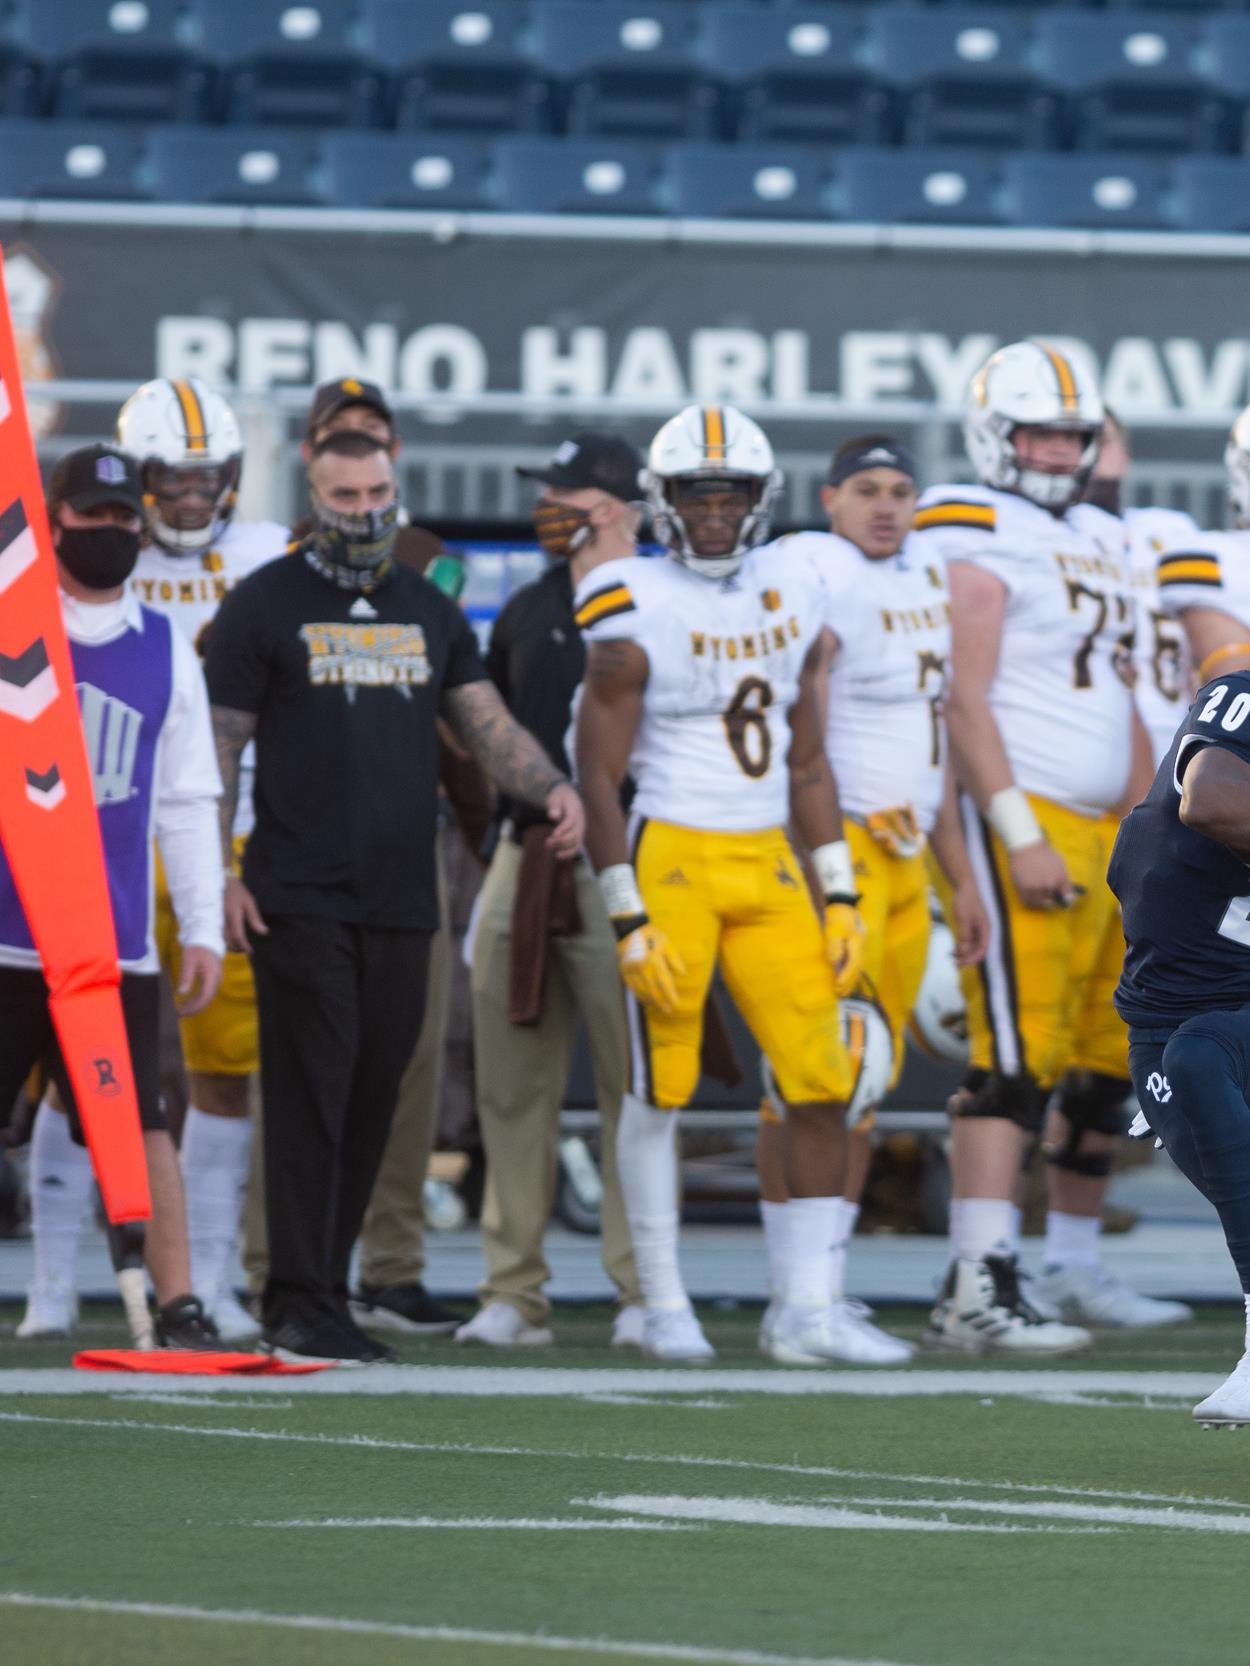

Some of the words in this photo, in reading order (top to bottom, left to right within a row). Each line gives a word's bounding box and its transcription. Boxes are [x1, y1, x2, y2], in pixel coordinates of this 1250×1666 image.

[155, 316, 488, 424] RENO
[521, 326, 1000, 426] HARLEY
[690, 616, 799, 661] WYOMING
[721, 675, 773, 780] 6
